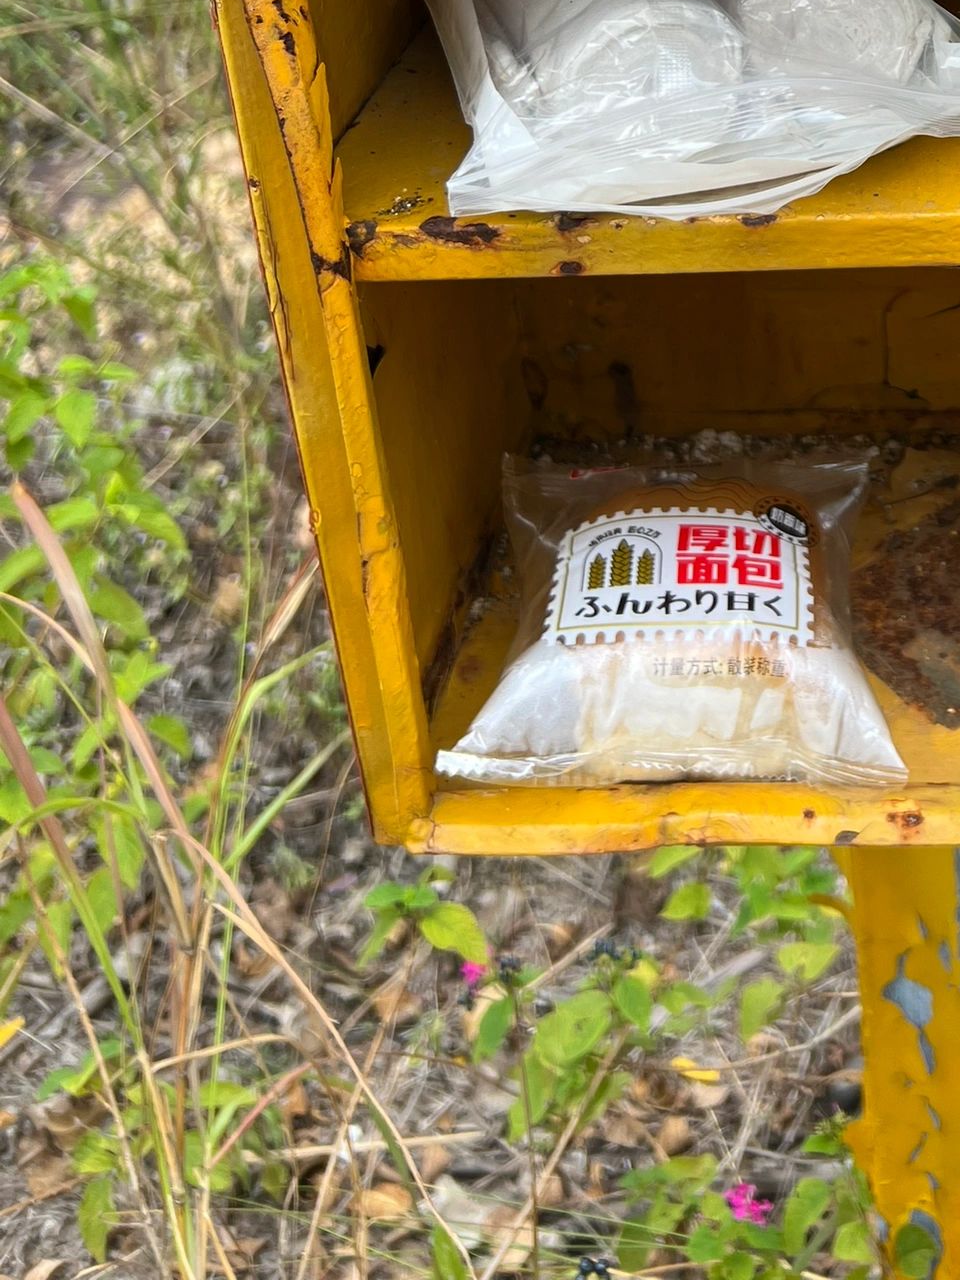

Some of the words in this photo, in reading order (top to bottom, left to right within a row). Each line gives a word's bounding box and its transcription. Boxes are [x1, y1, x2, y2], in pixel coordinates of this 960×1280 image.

[676, 524, 781, 554] 厚切
[675, 553, 784, 590] 面包
[575, 589, 783, 619] ふんわり甘く
